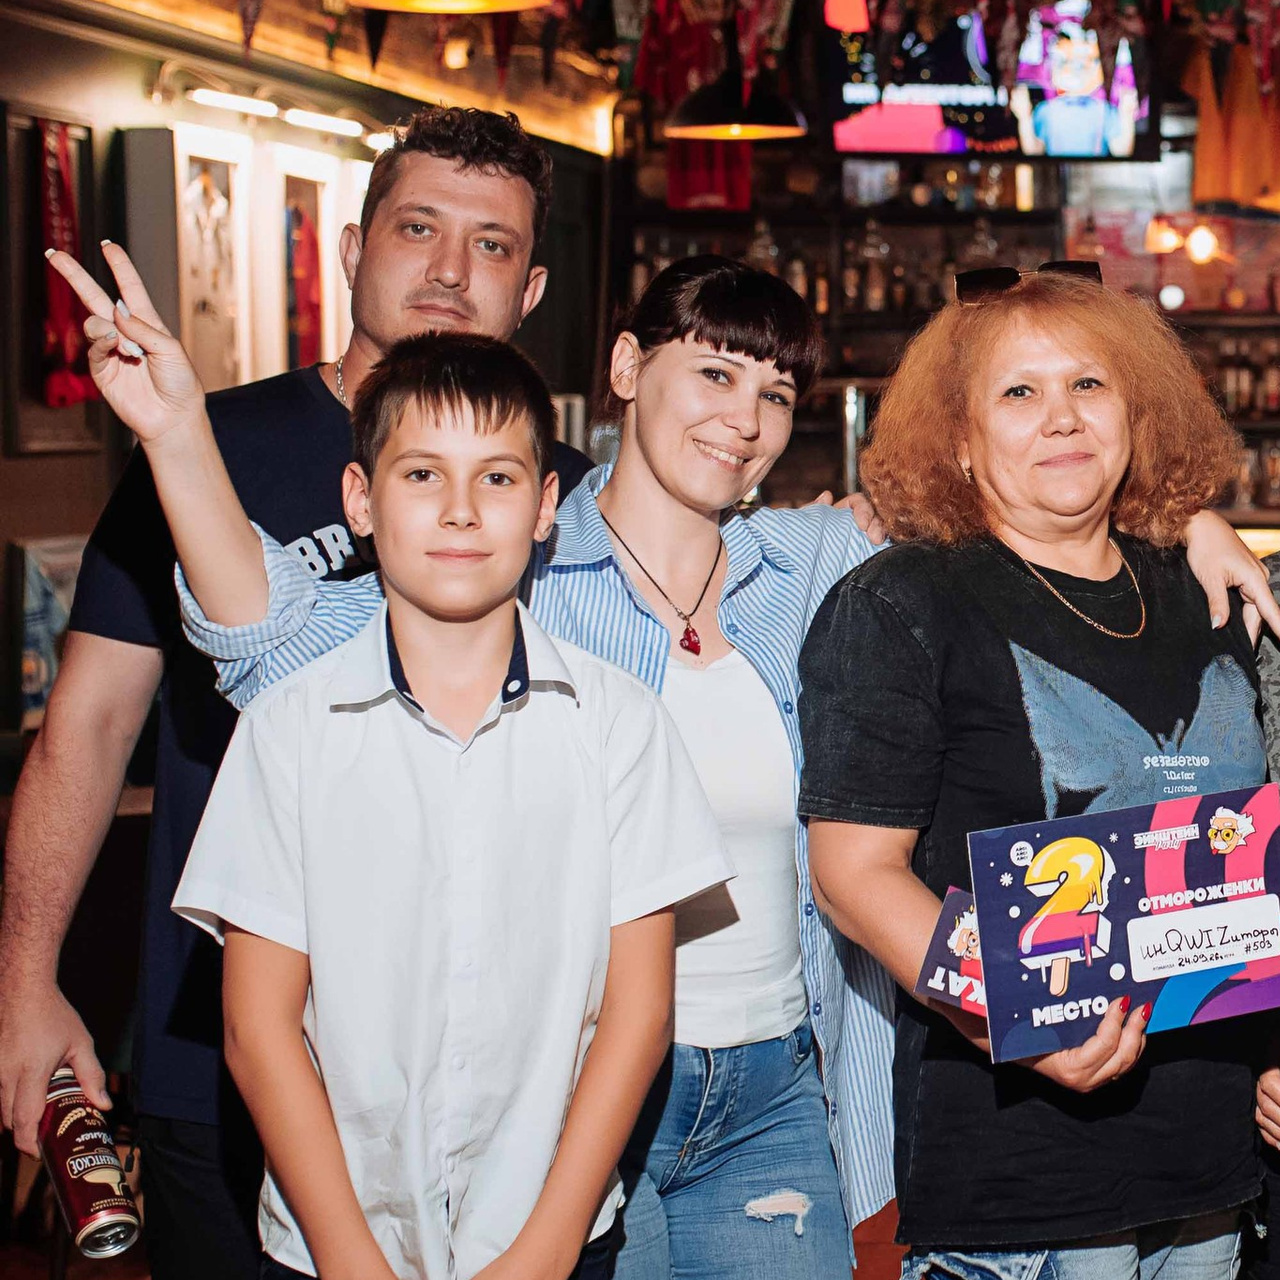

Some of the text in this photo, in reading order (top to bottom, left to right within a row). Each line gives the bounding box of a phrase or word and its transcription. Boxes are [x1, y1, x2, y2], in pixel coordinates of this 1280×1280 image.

[1138, 877, 1265, 912] ОТМОРОЖЕНКИ
[1245, 940, 1272, 954] #503
[1032, 996, 1109, 1027] МЕСТО
